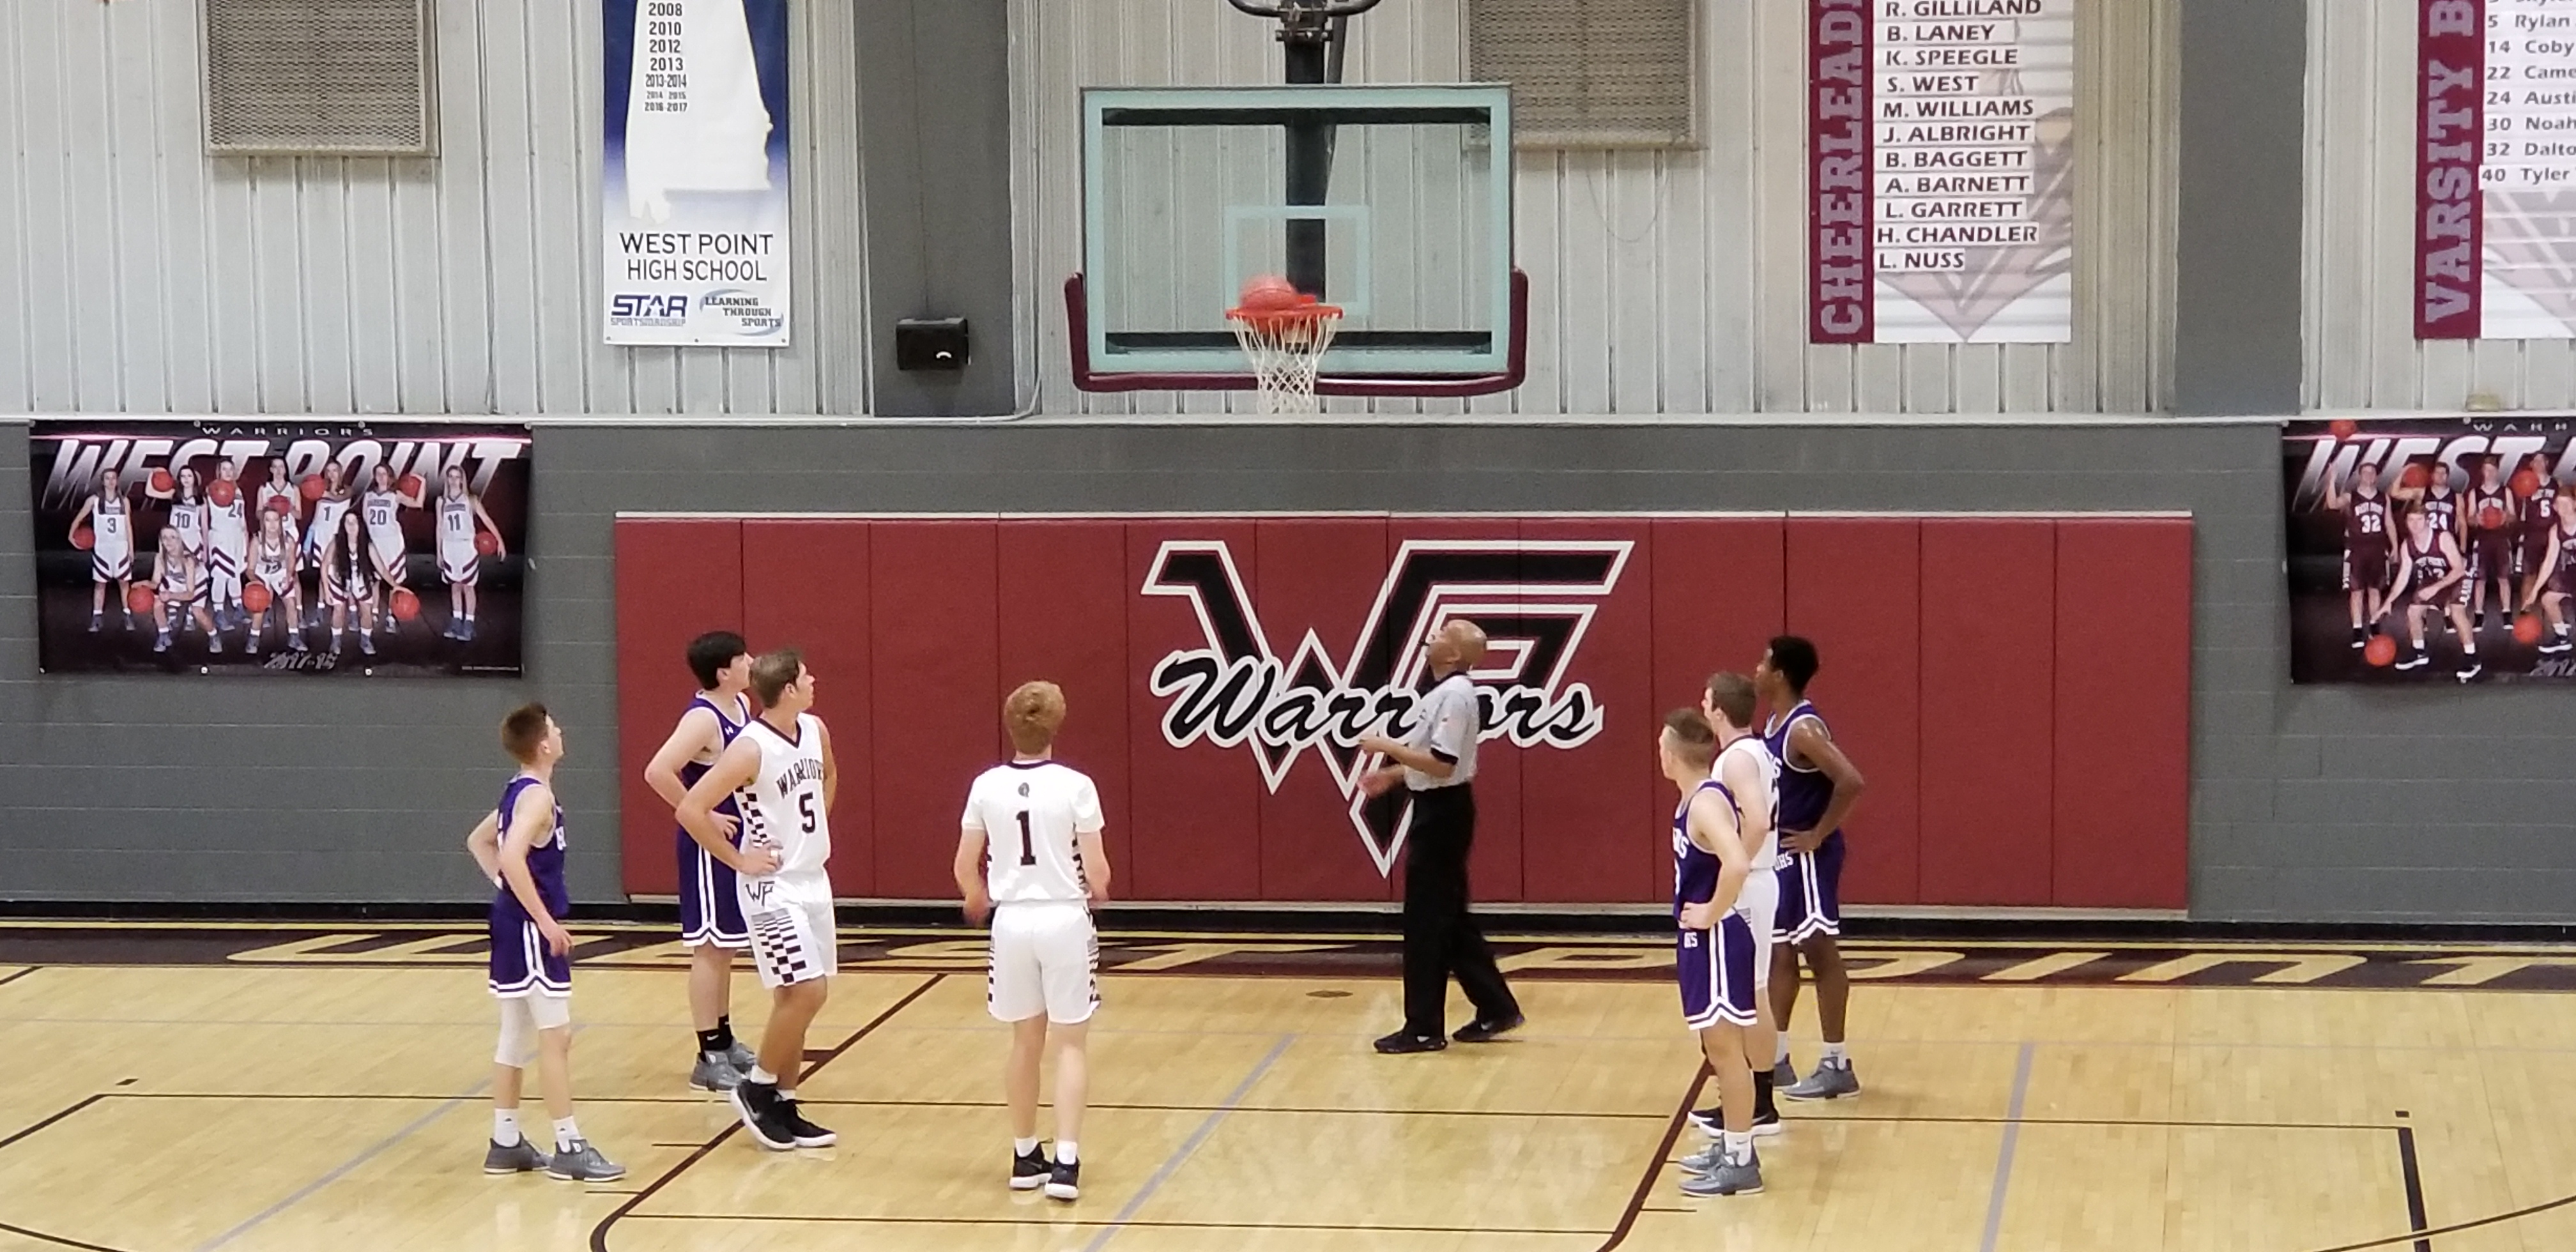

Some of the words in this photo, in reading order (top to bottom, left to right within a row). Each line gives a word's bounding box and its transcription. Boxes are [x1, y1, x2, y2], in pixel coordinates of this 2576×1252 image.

[648, 3, 682, 17] 2008
[1885, 0, 1906, 17] R.
[1914, 0, 2041, 15] GILLILAND
[649, 21, 682, 36] 2010
[2487, 15, 2498, 28] 5
[2515, 14, 2570, 32] Rylan
[1887, 26, 1907, 42] B.
[1916, 24, 1996, 41] LANEY
[649, 39, 680, 54] 2012
[2489, 40, 2511, 54] 14
[2525, 40, 2575, 57] Coby
[650, 57, 684, 72] 2013
[1885, 50, 1907, 66] K.
[1915, 49, 2018, 65] SPEEGLE
[2487, 66, 2511, 80] 22
[1887, 77, 1905, 93] S.
[1913, 75, 1979, 91] WEST
[2487, 91, 2511, 105] 24
[1883, 102, 1909, 118] M.
[1917, 100, 2033, 118] WILLIAMS
[2487, 118, 2511, 132] 30
[1883, 126, 1900, 143] J.
[1908, 125, 2030, 142] ALBRIGHT
[2487, 142, 2510, 156] 32
[1886, 153, 1906, 168] B.
[1914, 151, 2028, 167] BAGGETT
[2482, 168, 2506, 182] 40
[2520, 167, 2570, 185] Tyler
[1885, 178, 1910, 194] A.
[1917, 176, 2030, 193] BARNETT
[2425, 59, 2472, 323] VARSITY
[1886, 202, 1903, 219] L.
[1911, 201, 2022, 218] GARRETT
[1878, 227, 1900, 244] H.
[1906, 225, 2037, 243] CHANDLER
[620, 233, 691, 254] WEST
[699, 234, 774, 255] POINT
[1880, 253, 1897, 270] L.
[1905, 252, 1964, 268] NUSS
[628, 259, 677, 280] HIGH
[683, 260, 767, 281] SCHOOL
[611, 294, 688, 317] STAR
[705, 297, 758, 306] LEARNING
[723, 308, 771, 317] THROUGH
[741, 318, 781, 327] SPORTS
[107, 517, 117, 533] 3
[174, 512, 191, 530] 10
[370, 509, 387, 526] 20
[448, 514, 461, 531] 11
[2361, 514, 2382, 533] 32
[799, 791, 816, 834] 5
[1016, 809, 1037, 866] 1
